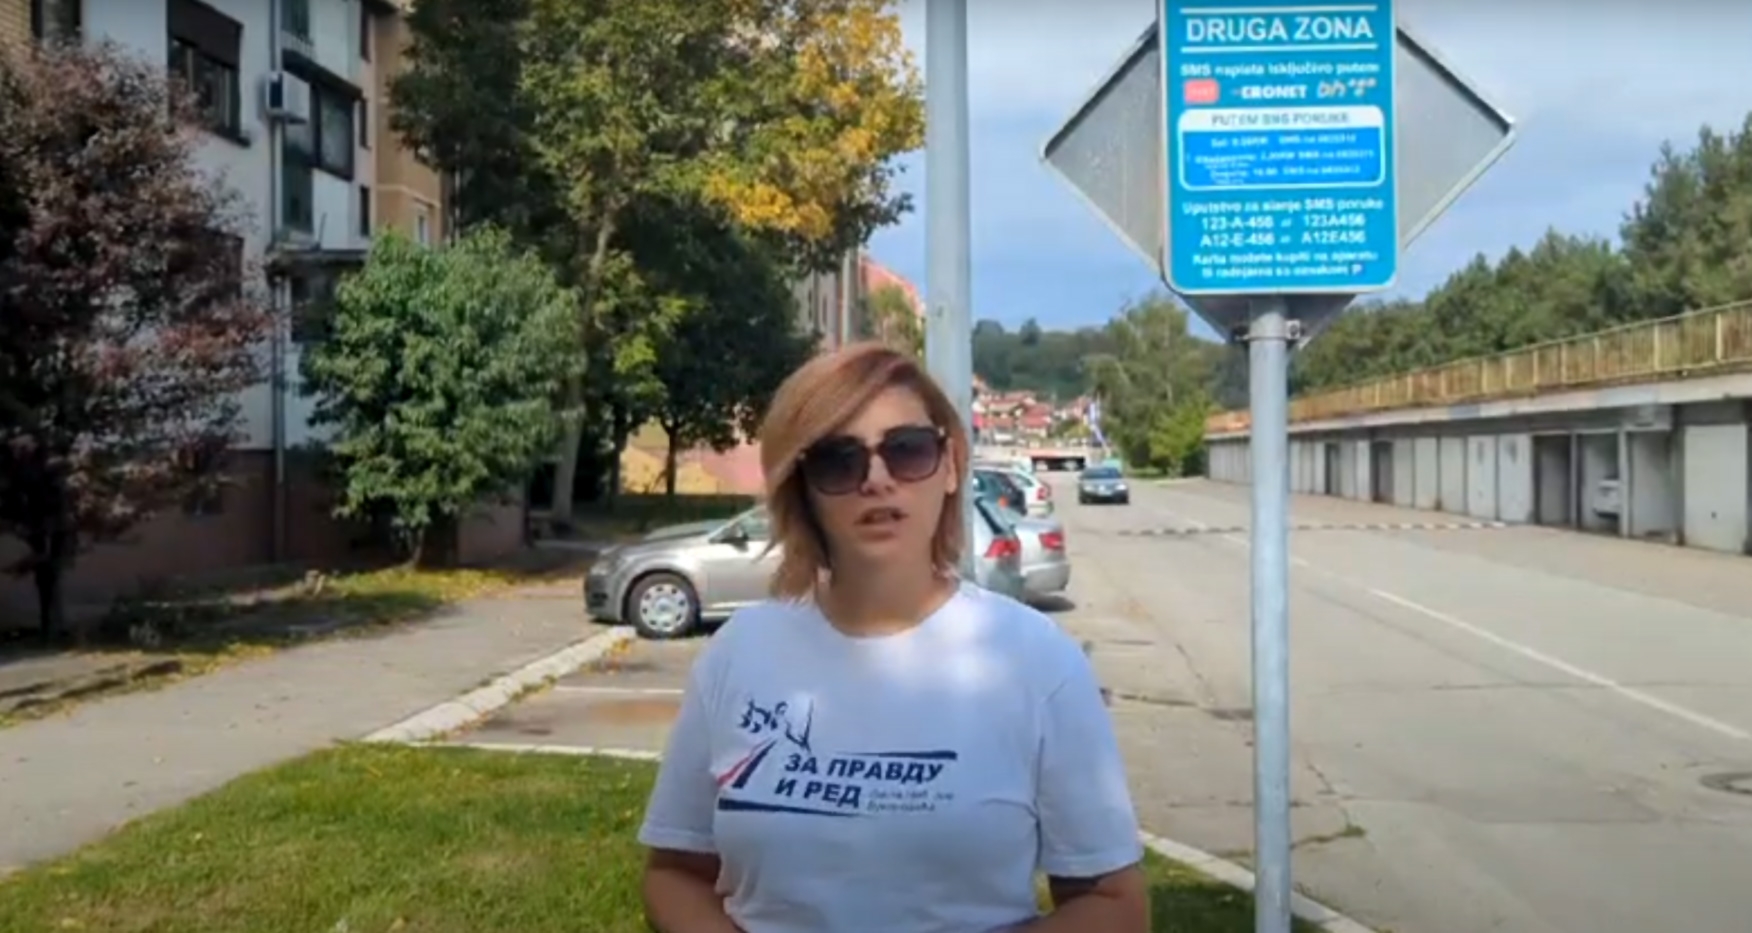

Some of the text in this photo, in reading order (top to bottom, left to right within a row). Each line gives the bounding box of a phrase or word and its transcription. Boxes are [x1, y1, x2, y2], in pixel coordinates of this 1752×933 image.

[1186, 16, 1374, 43] DRUGA ZONA
[1181, 63, 1212, 77] SMS
[1215, 64, 1265, 78] naplata
[1337, 62, 1380, 76] putem
[1211, 113, 1259, 127] PUTEM
[1293, 111, 1350, 125] PORUKE
[1182, 201, 1243, 216] Uputstvo
[1245, 202, 1260, 212] za
[1305, 197, 1335, 211] SMS
[1202, 212, 1367, 231] 123-A-456 123A456
[1200, 230, 1367, 248] A12-E-456 A12E456
[784, 753, 944, 785] ЗА ПРАВДУ
[774, 777, 798, 798] И
[803, 782, 862, 809] РЕД
